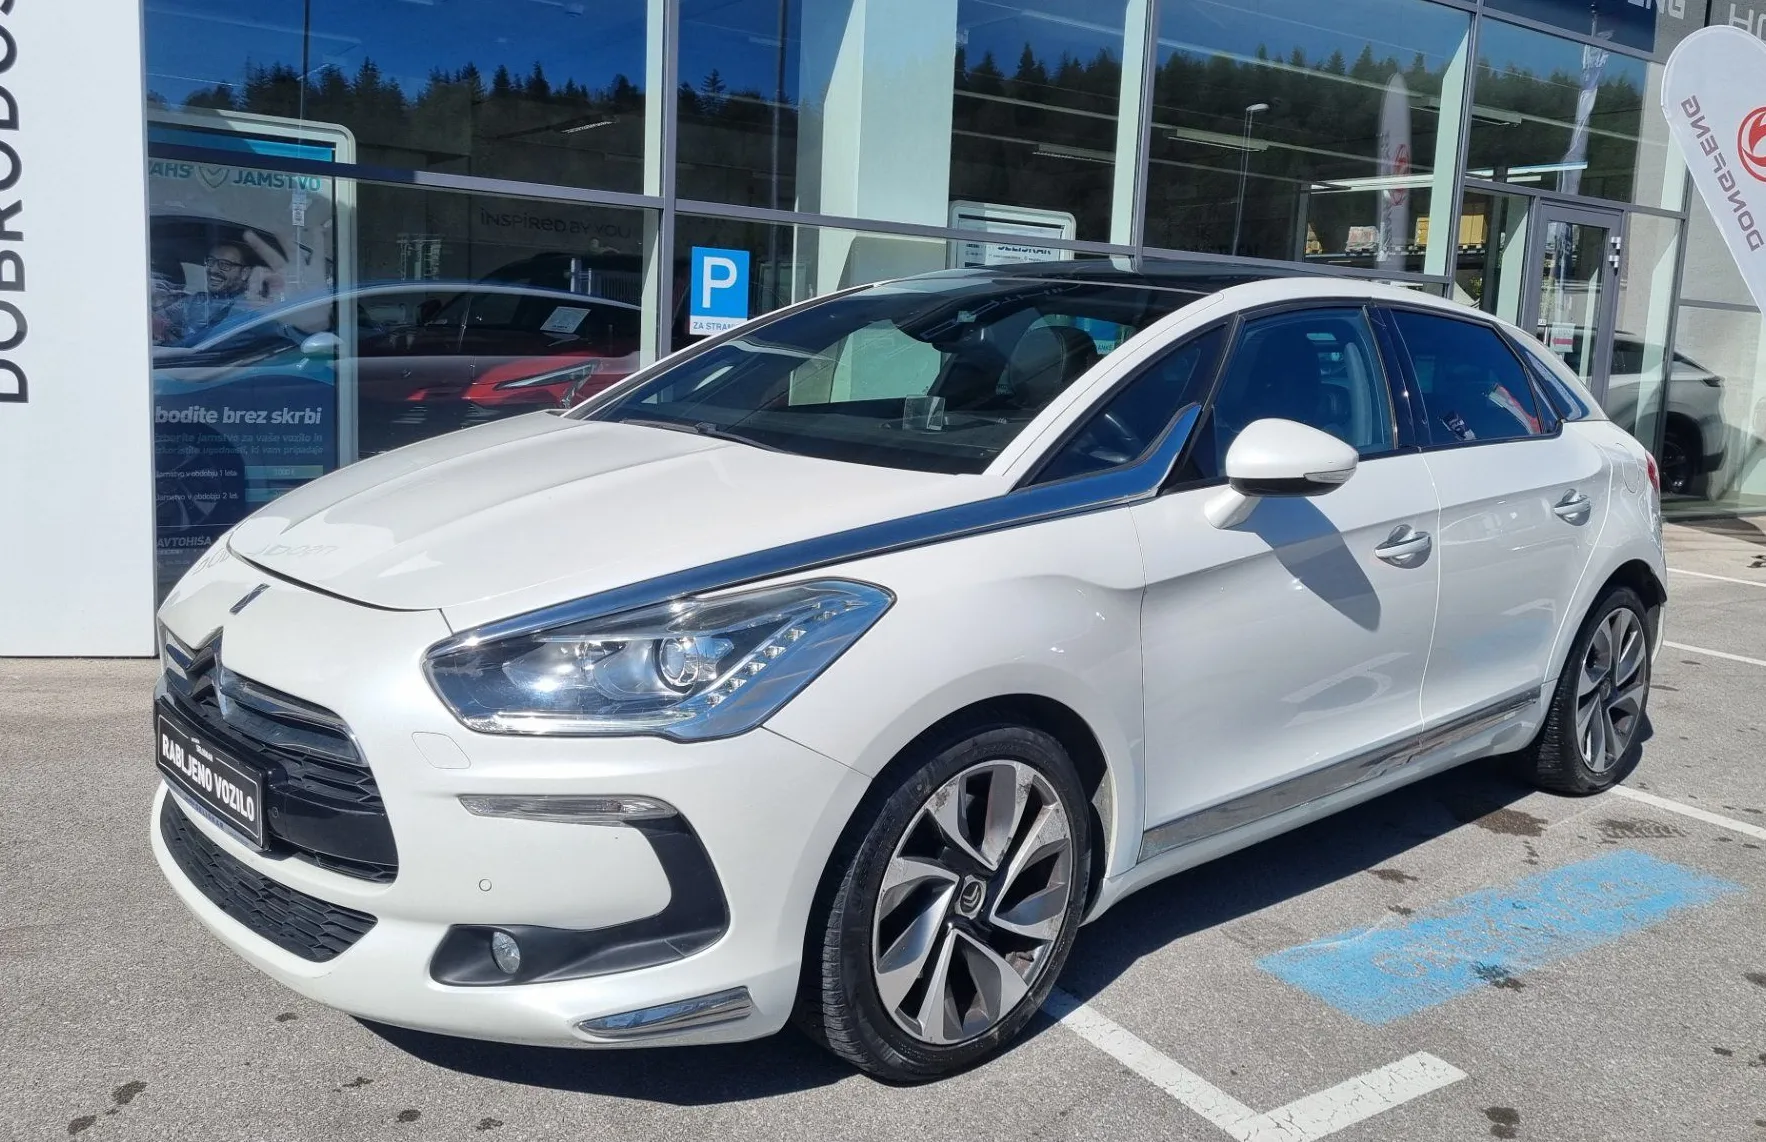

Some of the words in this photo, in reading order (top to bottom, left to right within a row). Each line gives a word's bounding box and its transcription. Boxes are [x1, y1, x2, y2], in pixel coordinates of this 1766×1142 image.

[232, 170, 321, 191] JAMSTVO
[702, 256, 738, 308] P
[693, 321, 704, 330] ZA
[155, 405, 218, 423] bodite
[222, 406, 268, 424] brez
[270, 407, 323, 424] skrbi
[162, 733, 213, 793] RABLJENO
[213, 772, 255, 822] VOZILO
